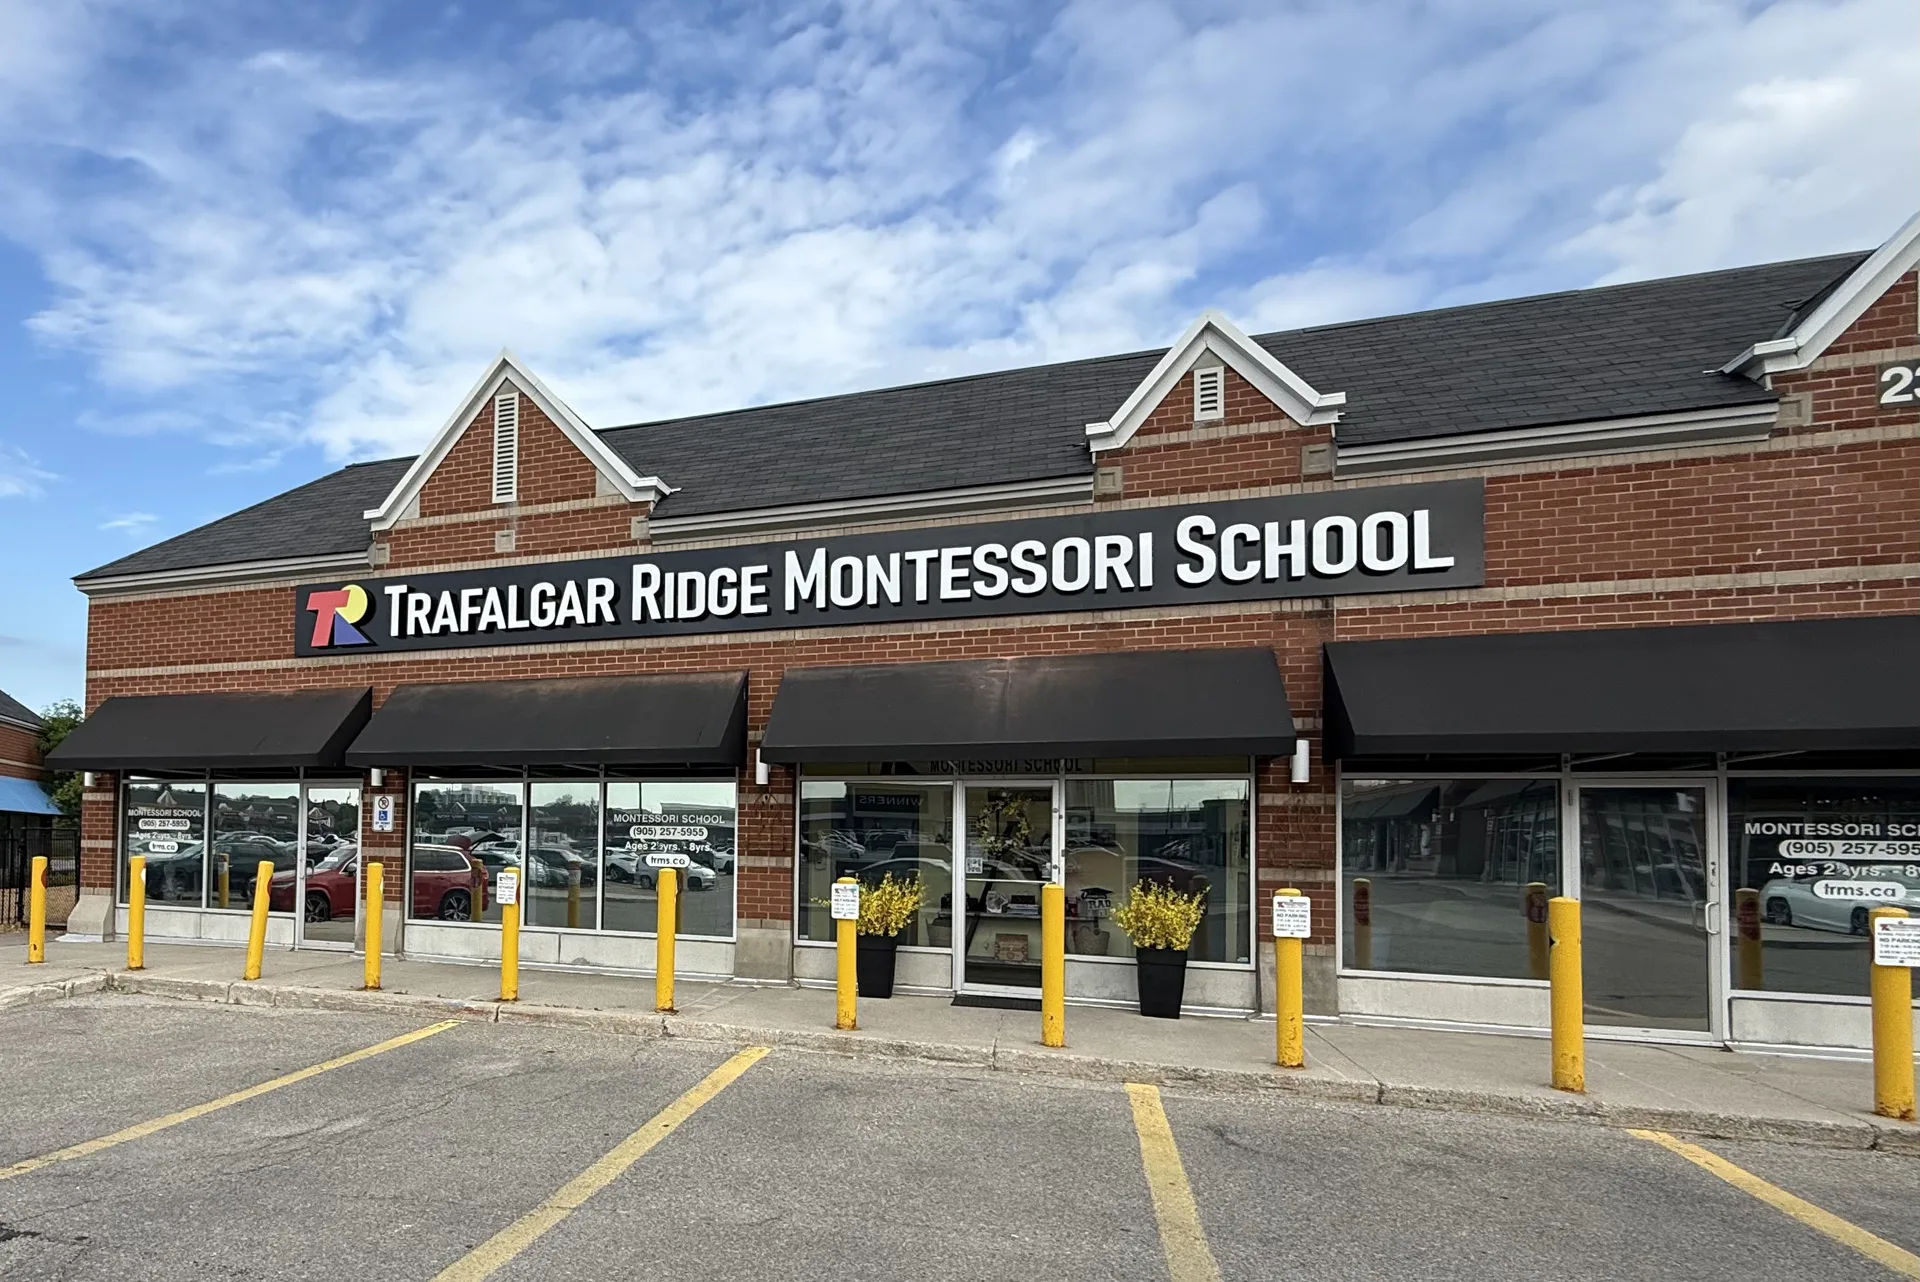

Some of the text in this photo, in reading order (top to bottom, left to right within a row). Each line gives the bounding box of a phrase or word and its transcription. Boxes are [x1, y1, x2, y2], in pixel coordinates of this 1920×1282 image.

[1880, 366, 1920, 404] 2
[384, 509, 1455, 638] TRAFALGAR RIDGE MONTESSORI SCHOOL
[128, 809, 201, 817] MONTESSORI SCHOOL
[613, 813, 726, 824] MONTESSORI SCHOOL
[633, 826, 705, 838] (905) 257-5955
[1744, 822, 1920, 837] MONTESSORI SC
[624, 841, 649, 852] Ages
[689, 842, 713, 853] 8yrs.
[1786, 842, 1834, 857] (905)
[650, 856, 686, 865] trms.ca
[1768, 862, 1818, 878] Ages
[1824, 883, 1896, 898] trms.ca
